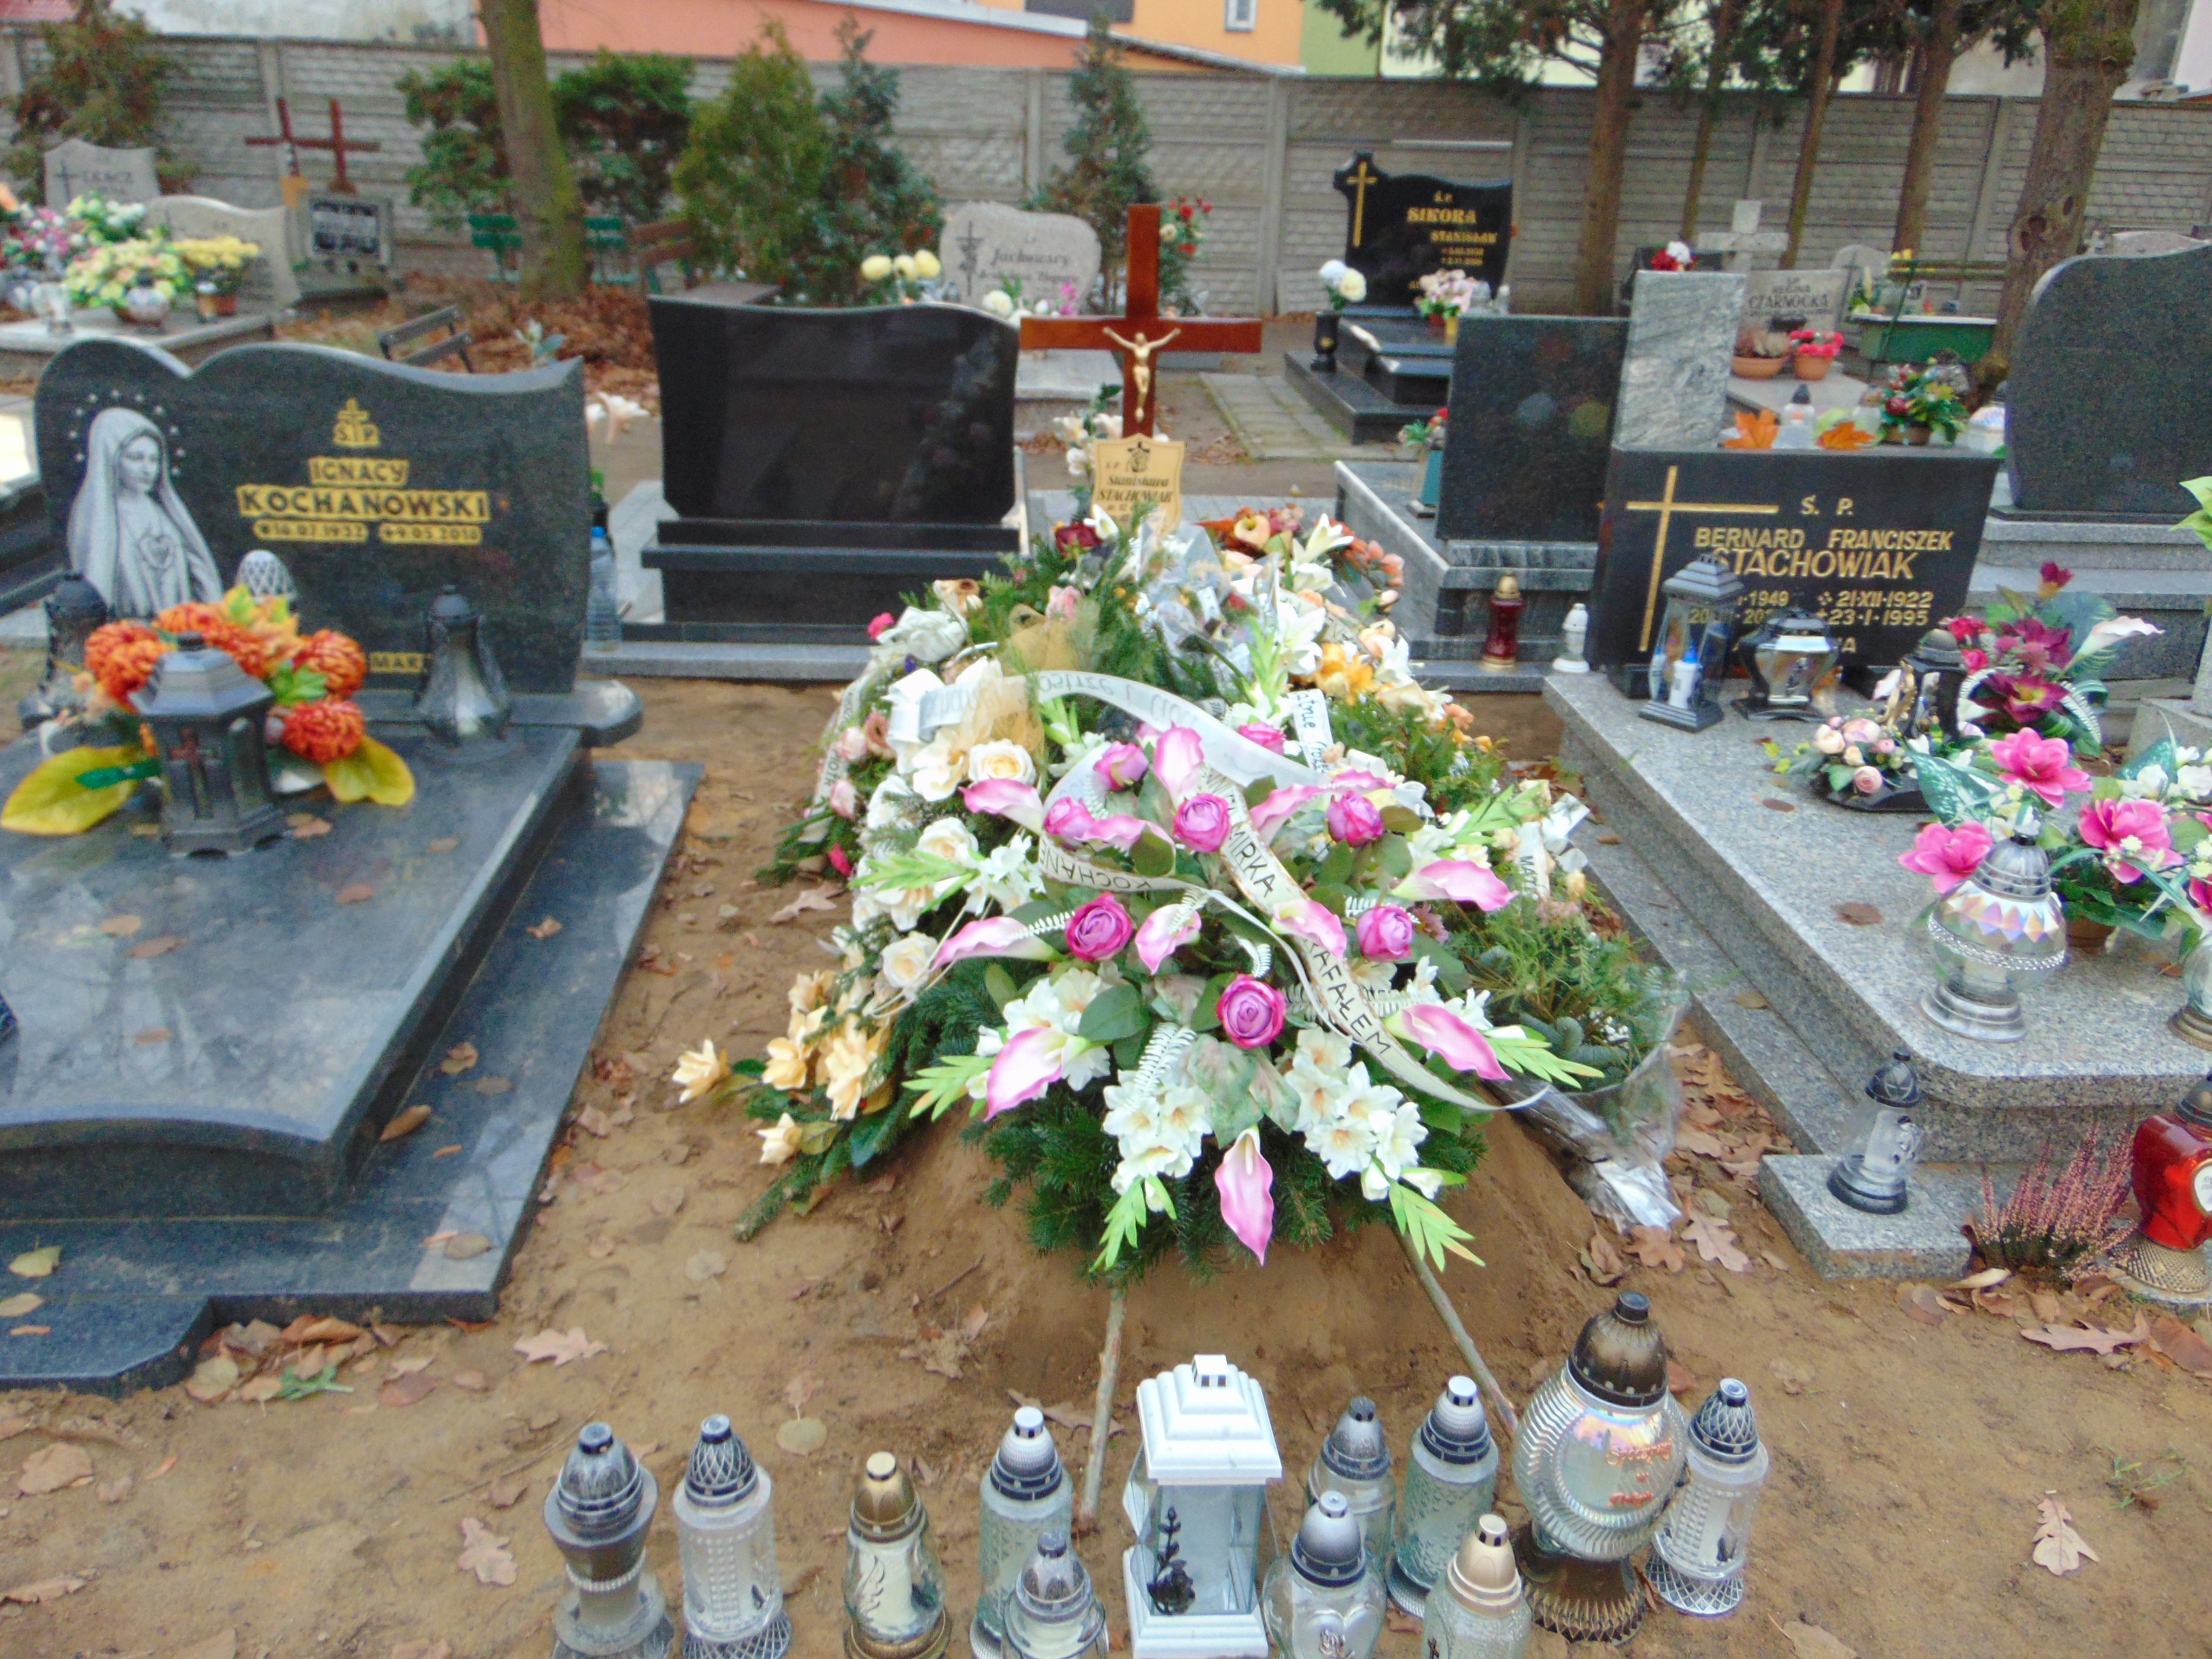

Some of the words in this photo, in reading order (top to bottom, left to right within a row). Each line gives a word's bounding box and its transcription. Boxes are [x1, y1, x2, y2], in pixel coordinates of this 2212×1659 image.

[1407, 207, 1476, 224] SIKORA
[313, 461, 407, 483] IGNACY
[243, 489, 486, 517] KOCHANOWSKI
[1694, 527, 1805, 548] BERNARD
[1828, 529, 1954, 551] FRANCISZEK
[1714, 548, 1919, 579] STACHOWIAK
[1228, 826, 1276, 898] MIRKA
